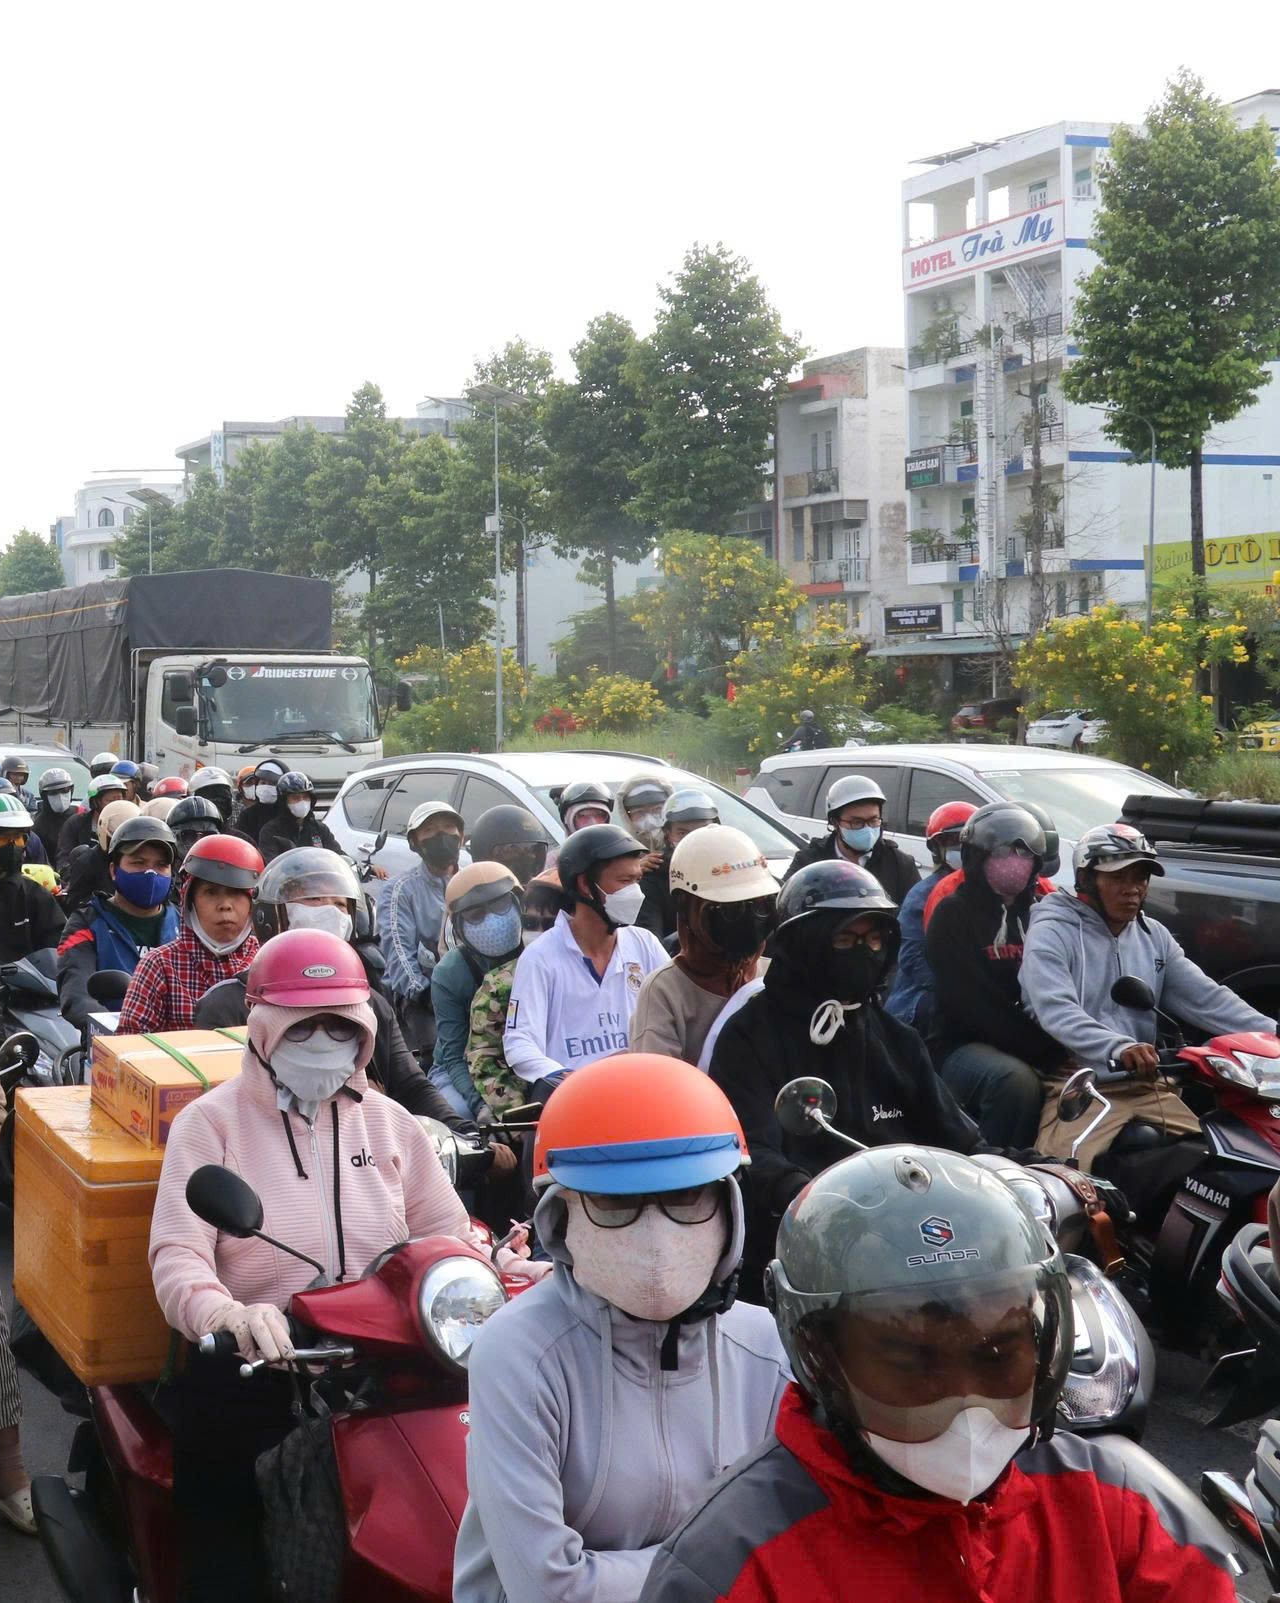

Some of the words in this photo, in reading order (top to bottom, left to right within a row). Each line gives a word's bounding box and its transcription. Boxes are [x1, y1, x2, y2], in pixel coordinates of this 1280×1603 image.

[910, 250, 956, 279] HOTEL
[961, 230, 1005, 262] Trà
[1013, 213, 1055, 246] My
[1204, 535, 1263, 567] ÔTÔ
[249, 666, 337, 679] BRIDGESTONE
[598, 1012, 620, 1027] Fly
[1184, 1176, 1230, 1208] YAMAHA
[906, 1248, 981, 1268] SUNDA
